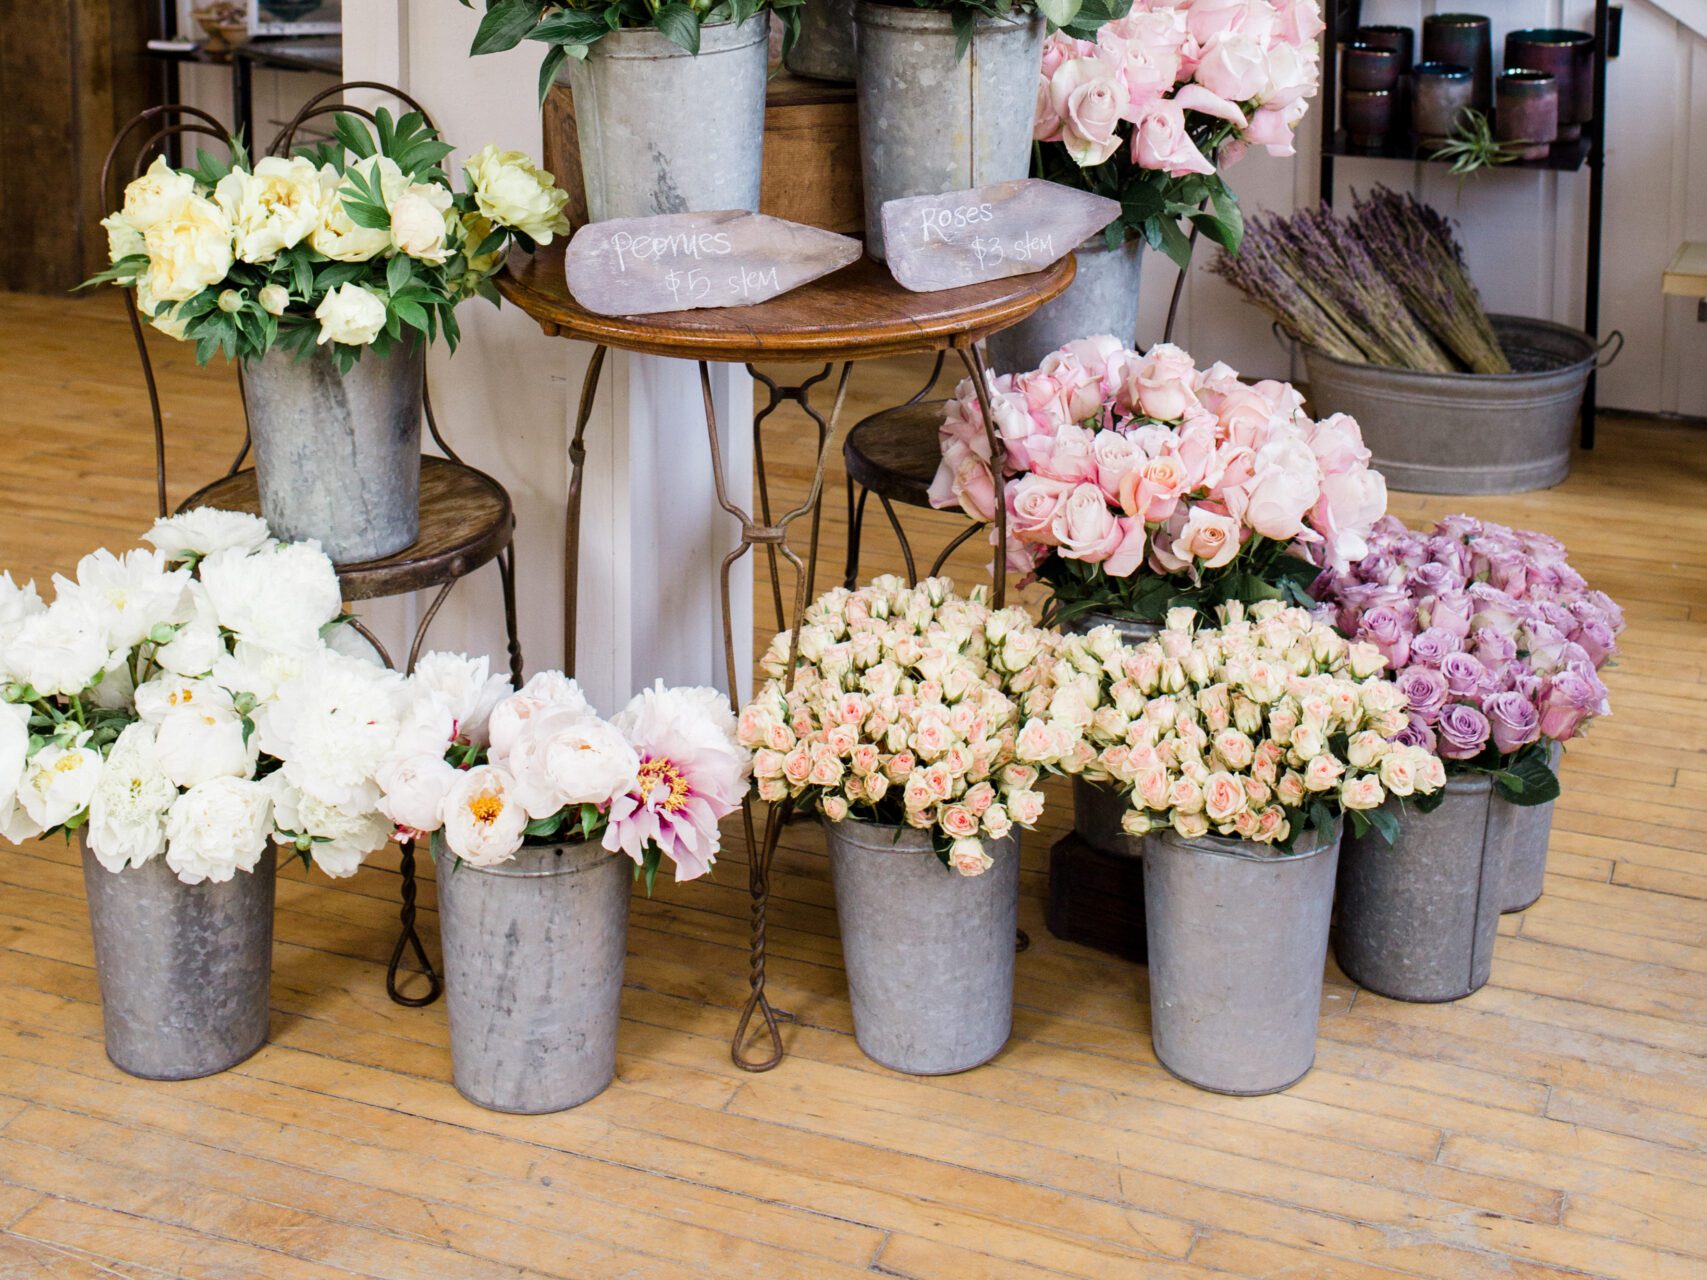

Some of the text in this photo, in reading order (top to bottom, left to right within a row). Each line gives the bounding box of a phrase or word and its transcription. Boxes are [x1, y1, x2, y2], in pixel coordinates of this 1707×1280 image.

[920, 203, 993, 242] Roses
[971, 235, 1004, 270] $3
[665, 268, 711, 303] $5
